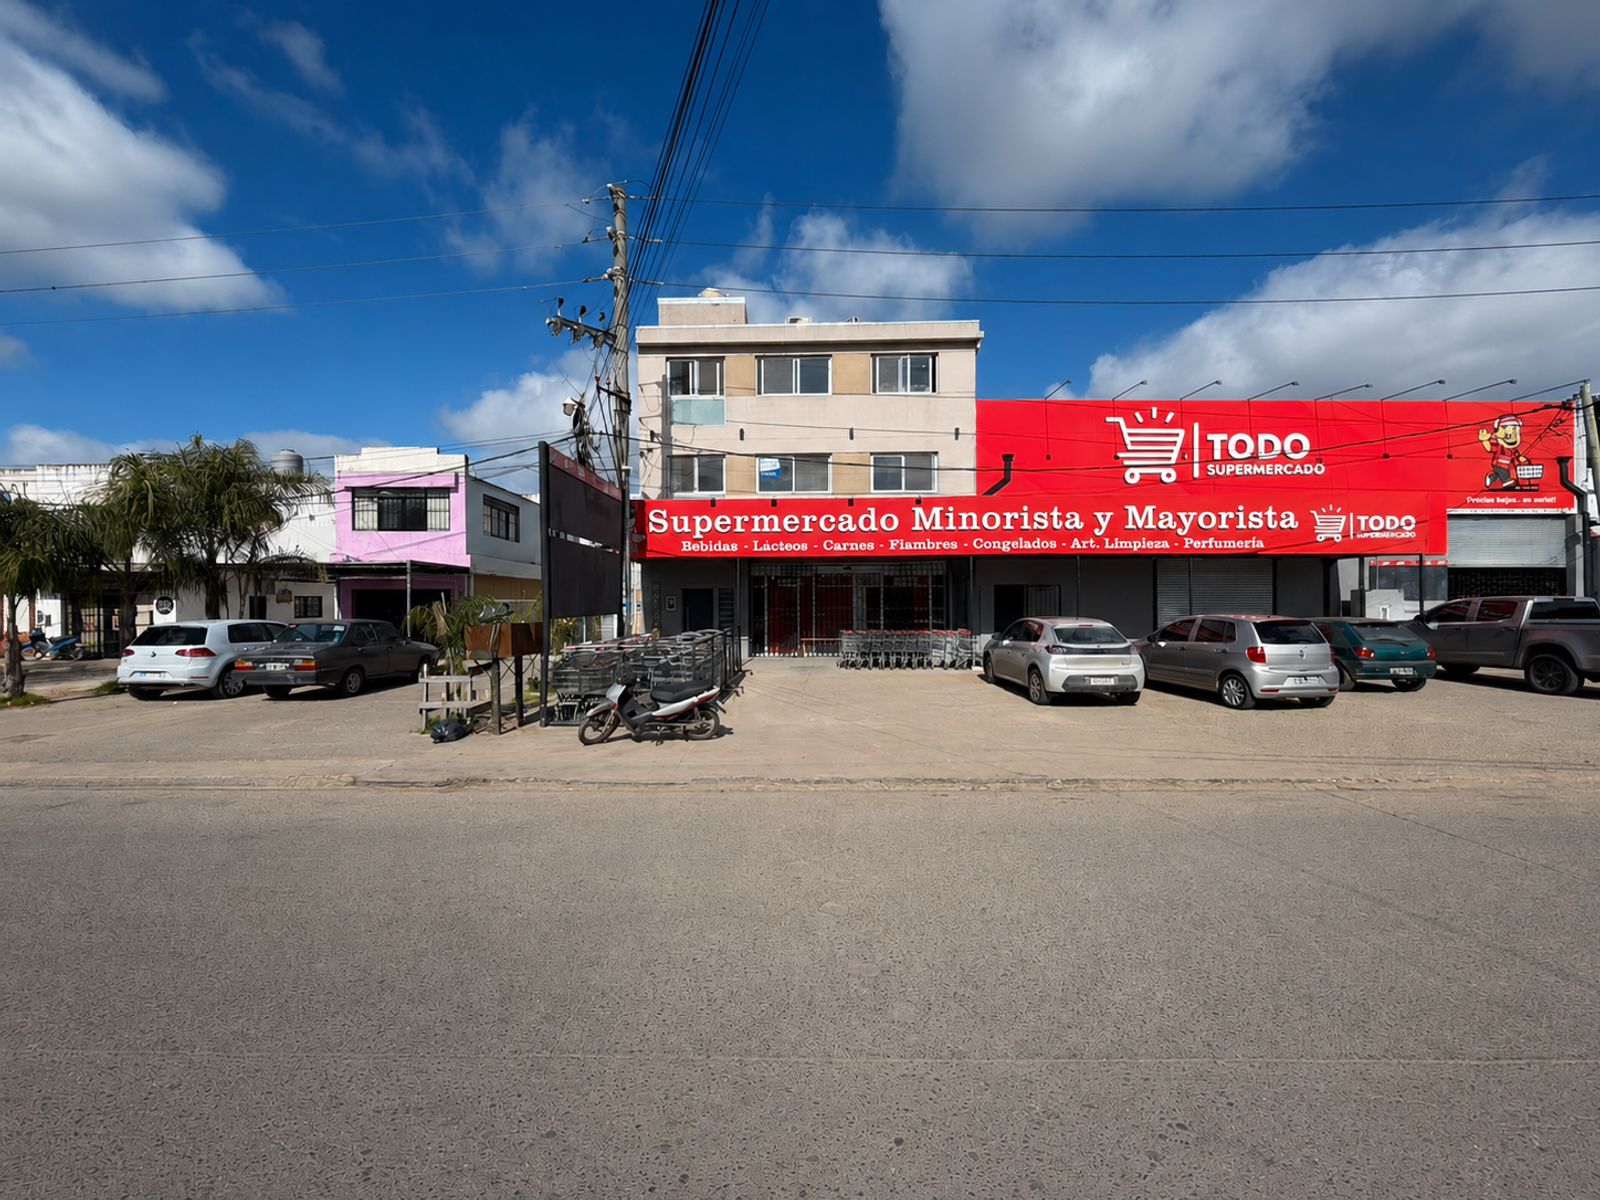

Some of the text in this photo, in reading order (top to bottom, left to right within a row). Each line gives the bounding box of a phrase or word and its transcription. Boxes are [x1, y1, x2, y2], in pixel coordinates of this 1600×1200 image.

[1206, 432, 1311, 460] TODO
[1206, 463, 1326, 476] SUPERMERCADO
[648, 504, 1299, 540] Supermercado Minorista y Mayorista
[1356, 514, 1416, 531] TODO
[681, 540, 738, 551] Bebidas
[823, 539, 875, 551] Carnes
[889, 539, 958, 550] Fiambres
[972, 537, 1057, 552] Congelados
[1070, 537, 1100, 549] Art.
[1104, 537, 1170, 551] Limpieza
[1183, 536, 1265, 549] Perfumería
